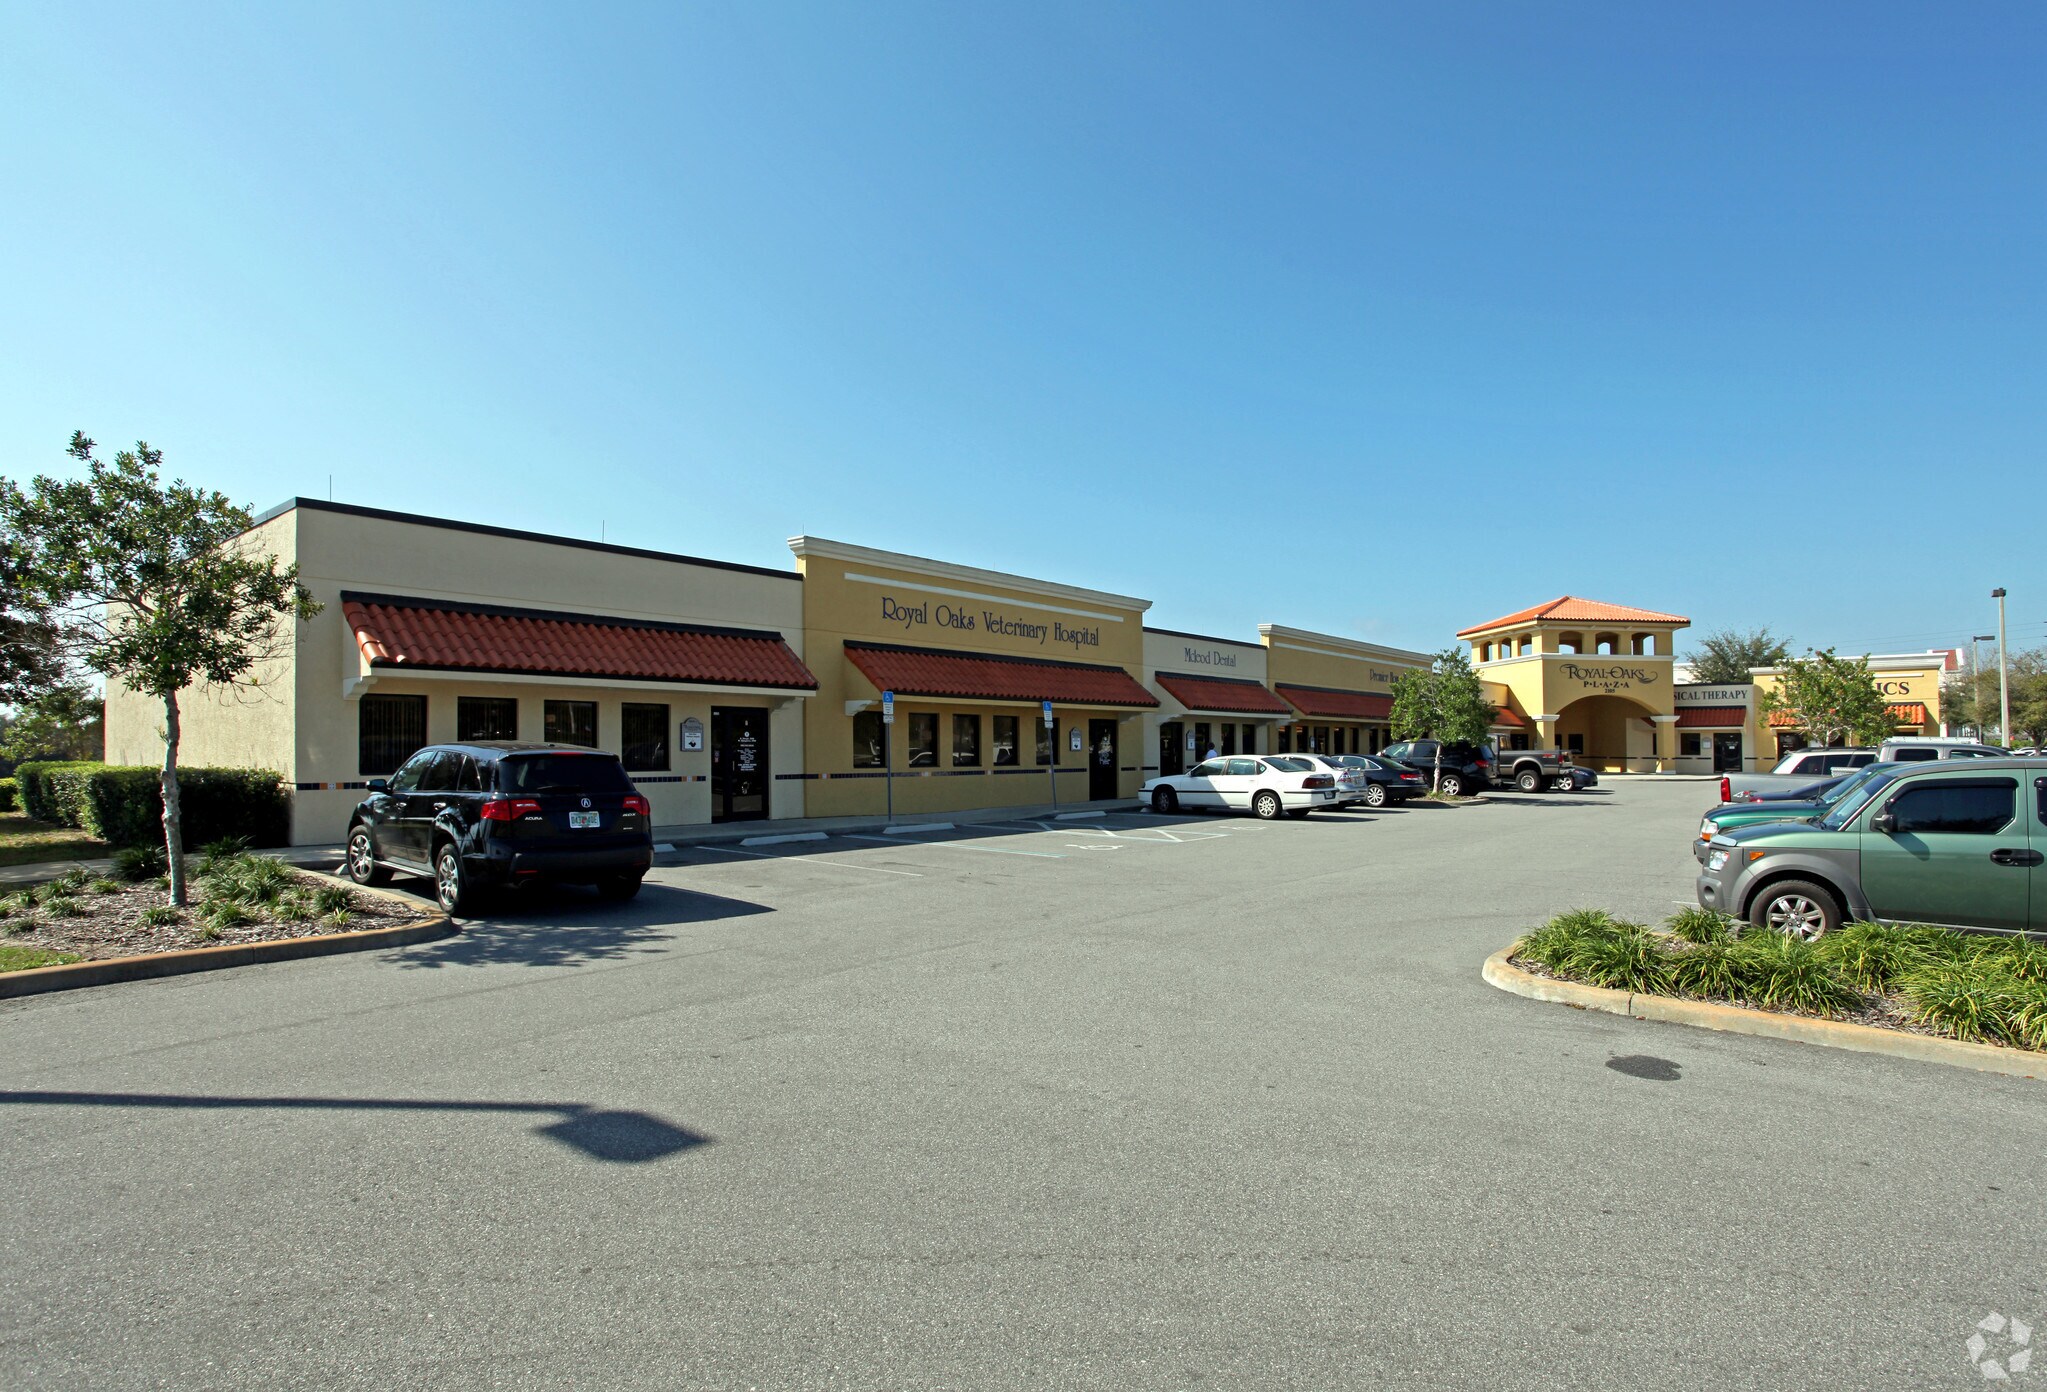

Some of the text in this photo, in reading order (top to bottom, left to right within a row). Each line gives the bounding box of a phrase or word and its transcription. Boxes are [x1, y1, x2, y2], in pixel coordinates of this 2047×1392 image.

[881, 597, 1099, 650] Royal Oaks Veterinary Hospital
[1213, 651, 1237, 667] Dental
[1560, 663, 1658, 684] ROYAL OAKS
[1701, 689, 1748, 700] THERAPY
